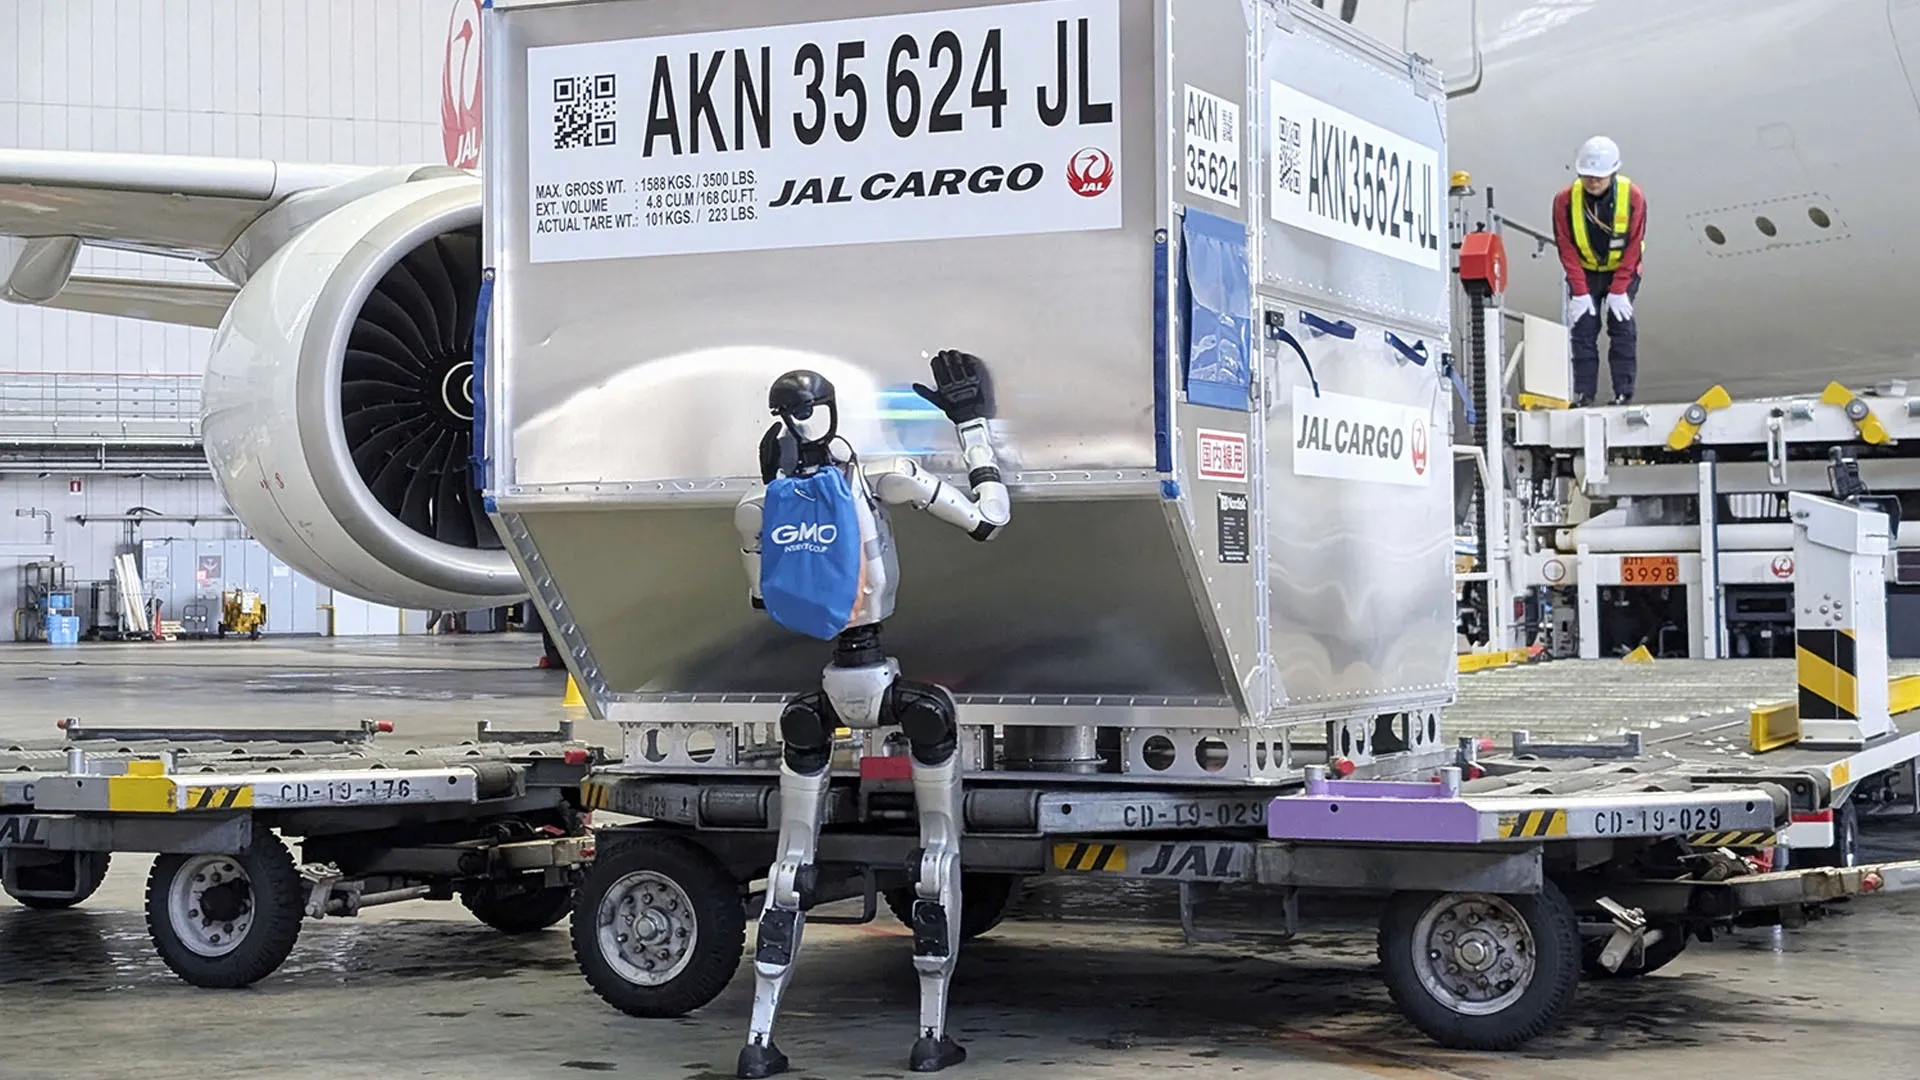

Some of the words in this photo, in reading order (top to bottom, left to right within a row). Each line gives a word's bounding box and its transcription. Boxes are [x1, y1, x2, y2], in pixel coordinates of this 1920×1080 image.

[642, 45, 771, 158] AKN
[1036, 17, 1113, 128] JL
[1187, 91, 1218, 143] AKN
[454, 127, 478, 168] JAL
[536, 184, 562, 199] MAX.
[565, 181, 604, 197] GROSS
[607, 179, 626, 194] WT.
[703, 172, 729, 187] 3500
[732, 170, 758, 185] LBS.
[768, 176, 853, 207] JAL
[859, 162, 1044, 201] CARGO
[1078, 181, 1105, 193] JAL
[1187, 144, 1238, 201] 35624
[536, 202, 560, 216] EXT.
[562, 198, 608, 214] VOLUME
[646, 195, 662, 209] 4.8
[666, 192, 694, 208] CU.M
[537, 216, 580, 234] ACTUAL
[583, 214, 613, 231] TARE
[708, 207, 728, 223] 223
[731, 205, 758, 221] LBS.
[1202, 441, 1242, 471] 国内線用
[771, 522, 838, 544] GMO
[1624, 567, 1675, 582] 3998
[281, 779, 411, 802] CD-19-176
[0, 817, 45, 845] AL
[1595, 807, 1722, 834] CD-19-029
[1141, 844, 1242, 878] JAL
